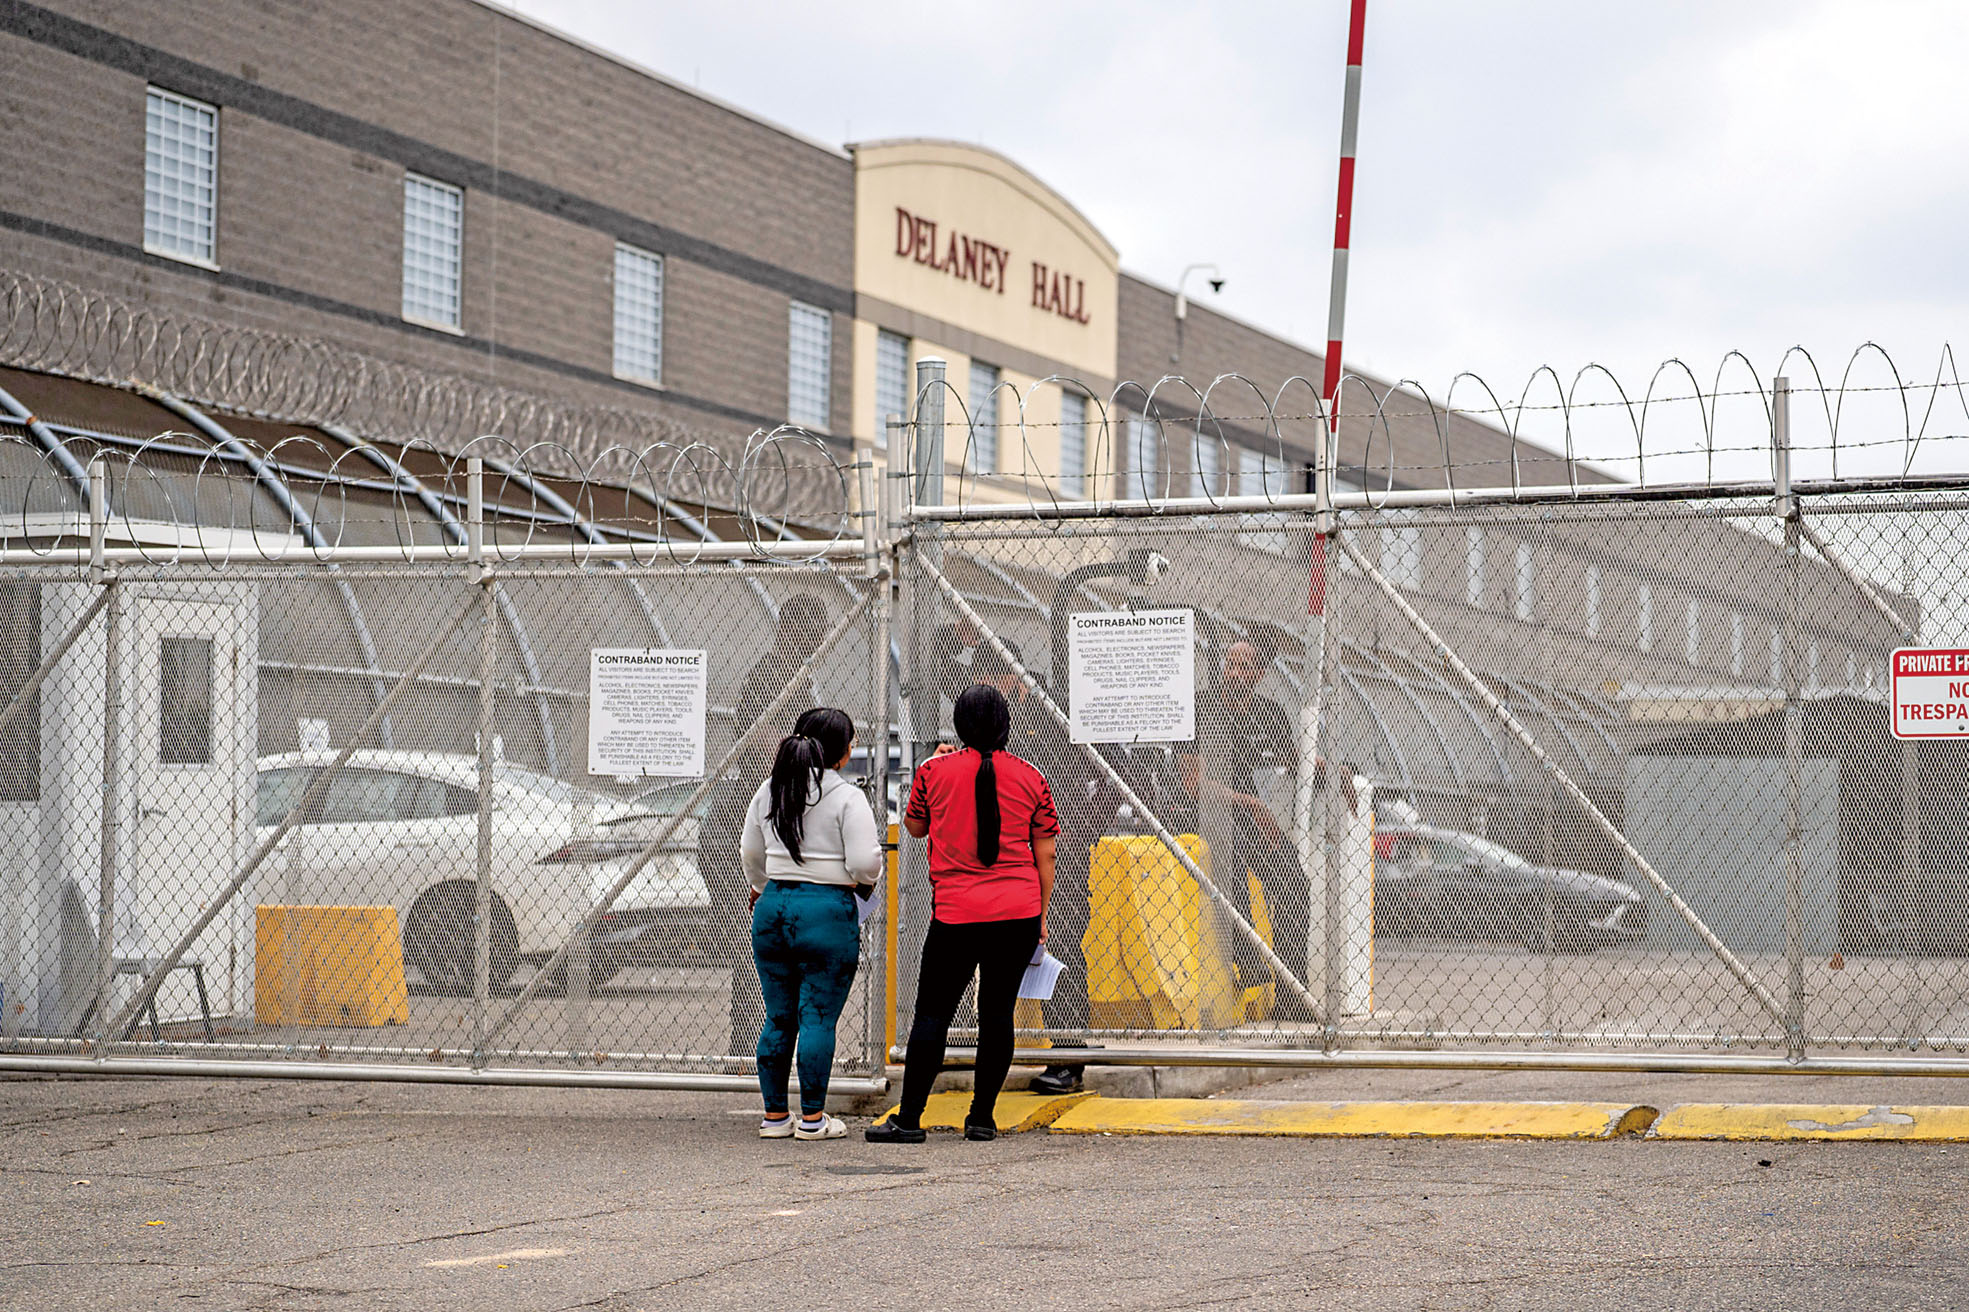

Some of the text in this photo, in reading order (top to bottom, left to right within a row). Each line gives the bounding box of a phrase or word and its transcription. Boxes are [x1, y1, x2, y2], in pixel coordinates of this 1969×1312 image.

[896, 207, 1090, 325] DELANEY HALL
[1077, 617, 1185, 628] CONTRABAND NOTICE
[598, 656, 662, 664] CONTRABAND
[1900, 655, 1952, 672] PRIVATE
[1900, 704, 1968, 720] TRESPA
